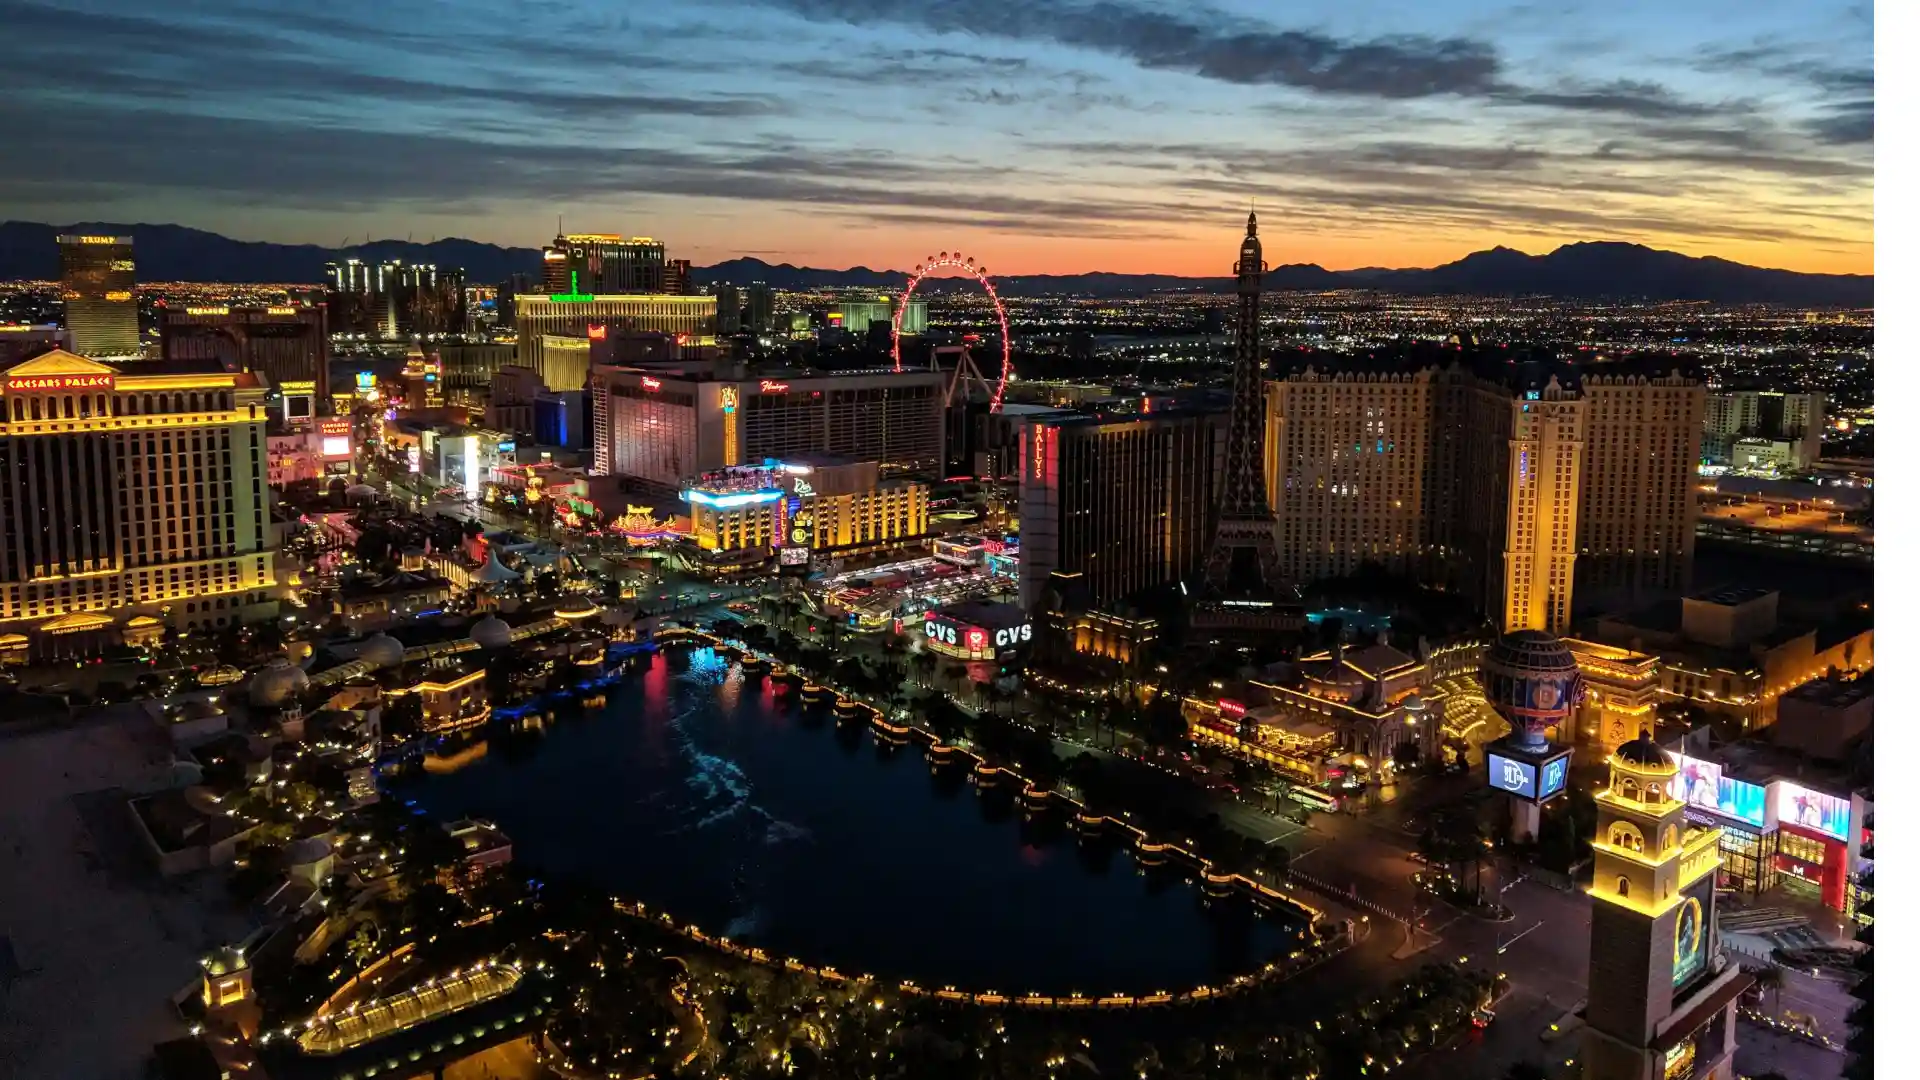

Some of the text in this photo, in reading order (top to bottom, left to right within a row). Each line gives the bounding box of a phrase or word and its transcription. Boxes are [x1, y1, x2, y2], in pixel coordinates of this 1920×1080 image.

[81, 236, 116, 245] TRUMP
[8, 376, 111, 389] CAESARS PALACE
[925, 621, 957, 645] CVS
[996, 624, 1032, 646] CVS
